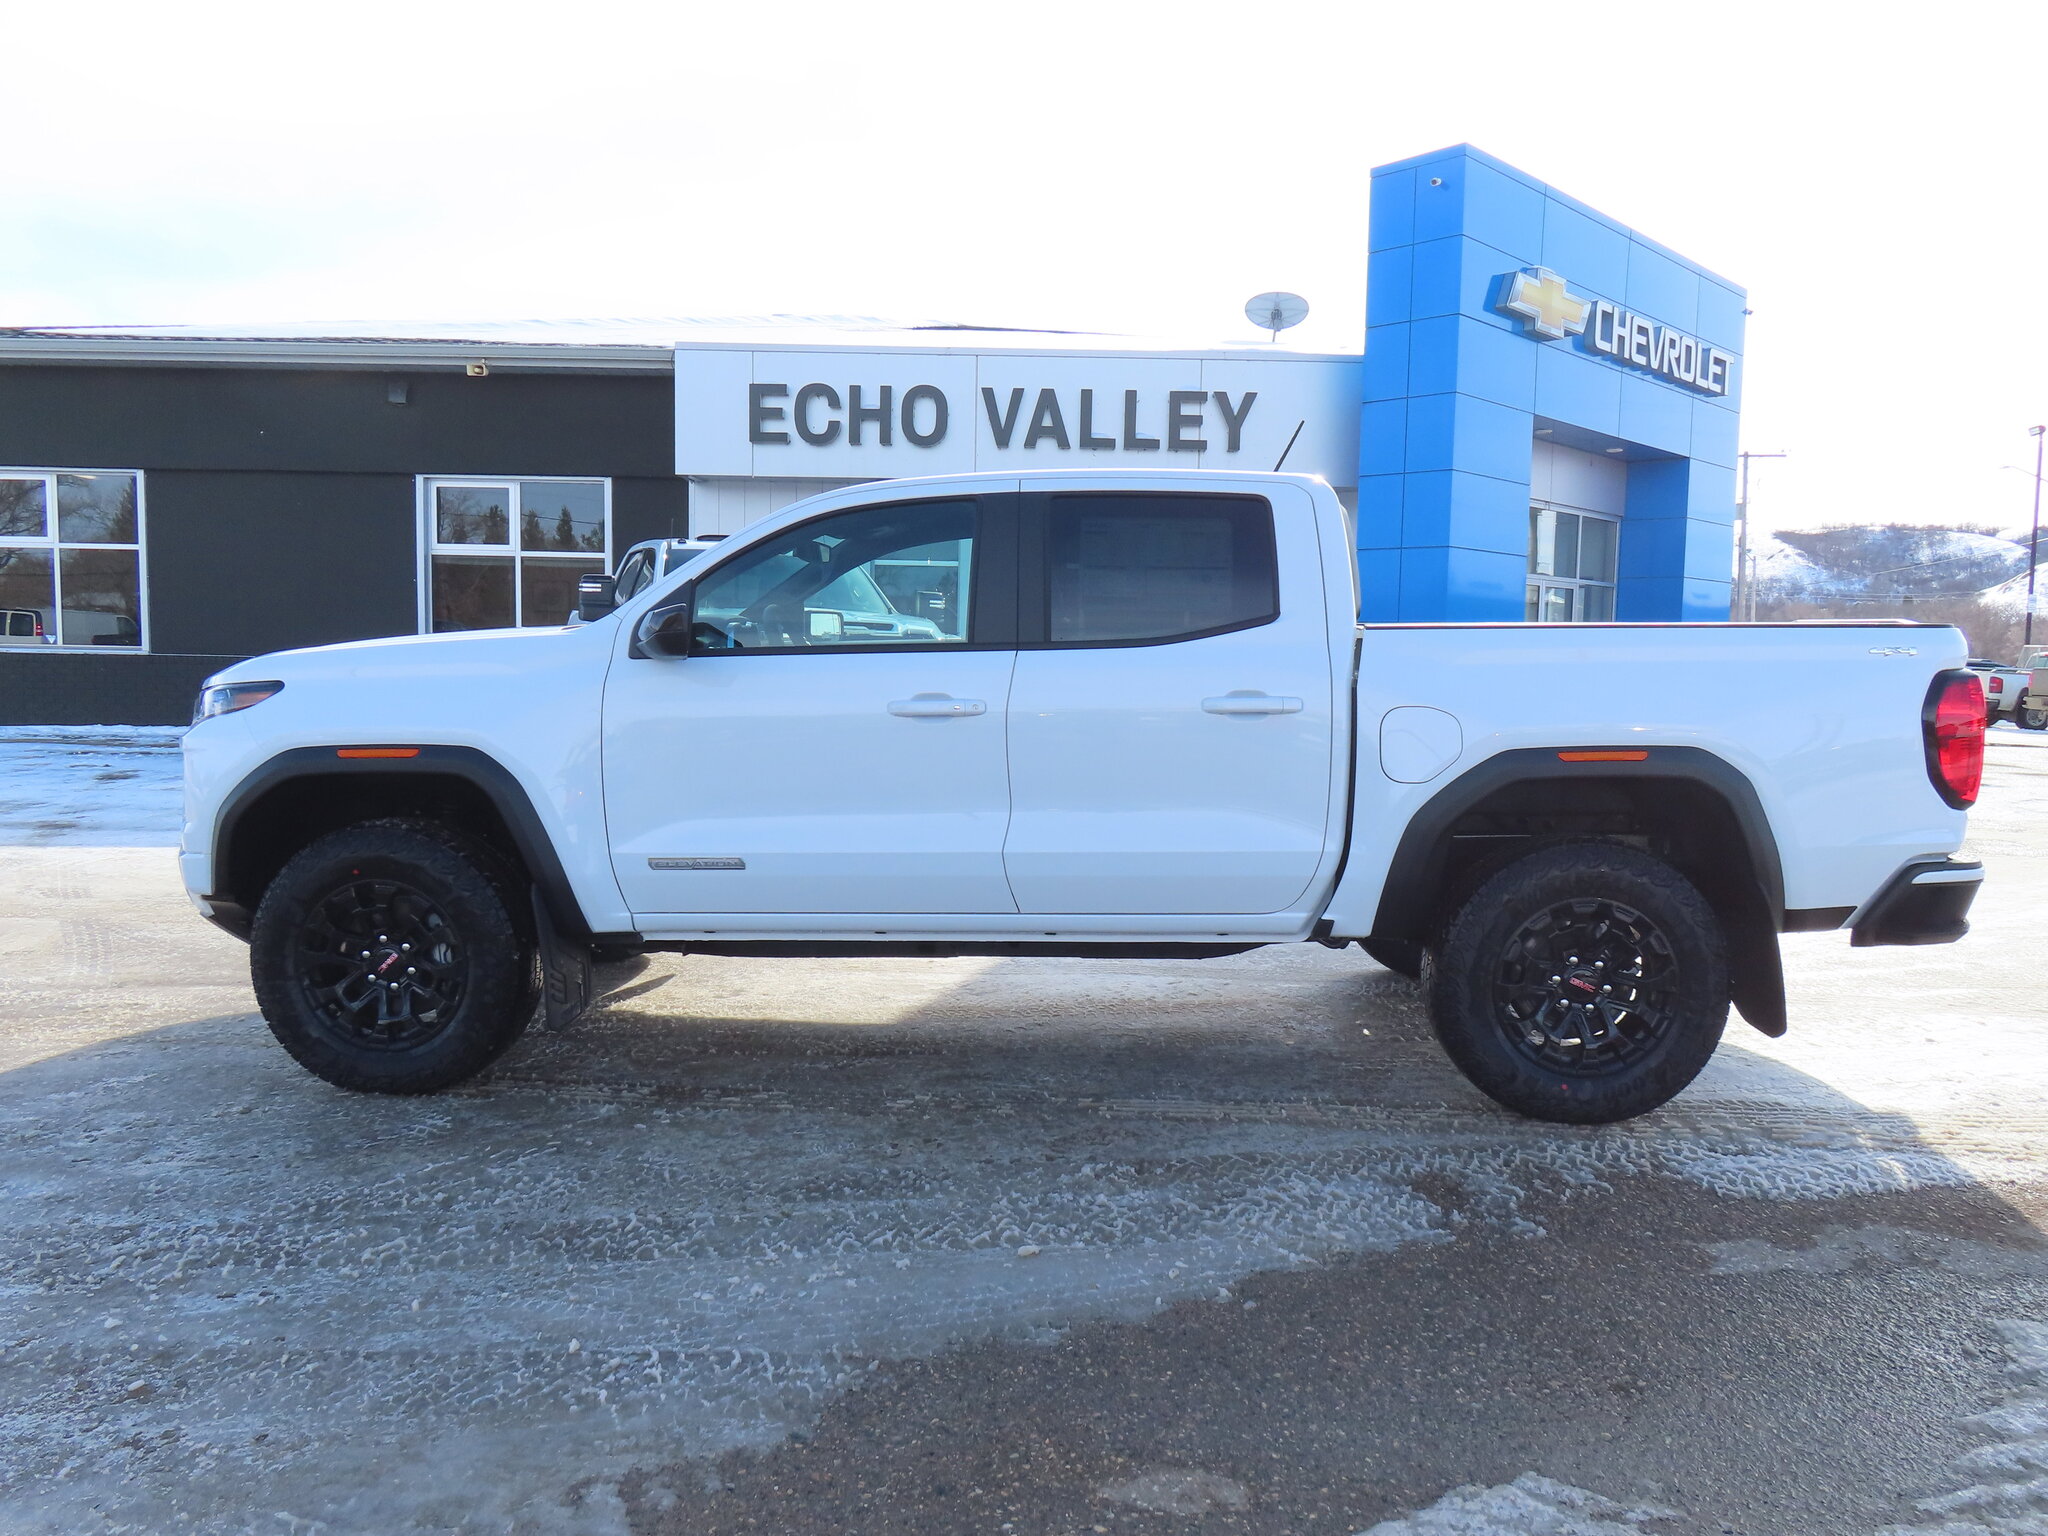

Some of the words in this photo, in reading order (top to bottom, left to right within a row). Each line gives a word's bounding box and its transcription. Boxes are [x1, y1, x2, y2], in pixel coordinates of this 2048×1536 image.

[1588, 299, 1735, 397] CHEVROLET
[749, 382, 949, 448] ECHO
[981, 387, 1258, 453] VALLEY
[377, 952, 399, 974] GMC
[1569, 977, 1596, 993] GMC
